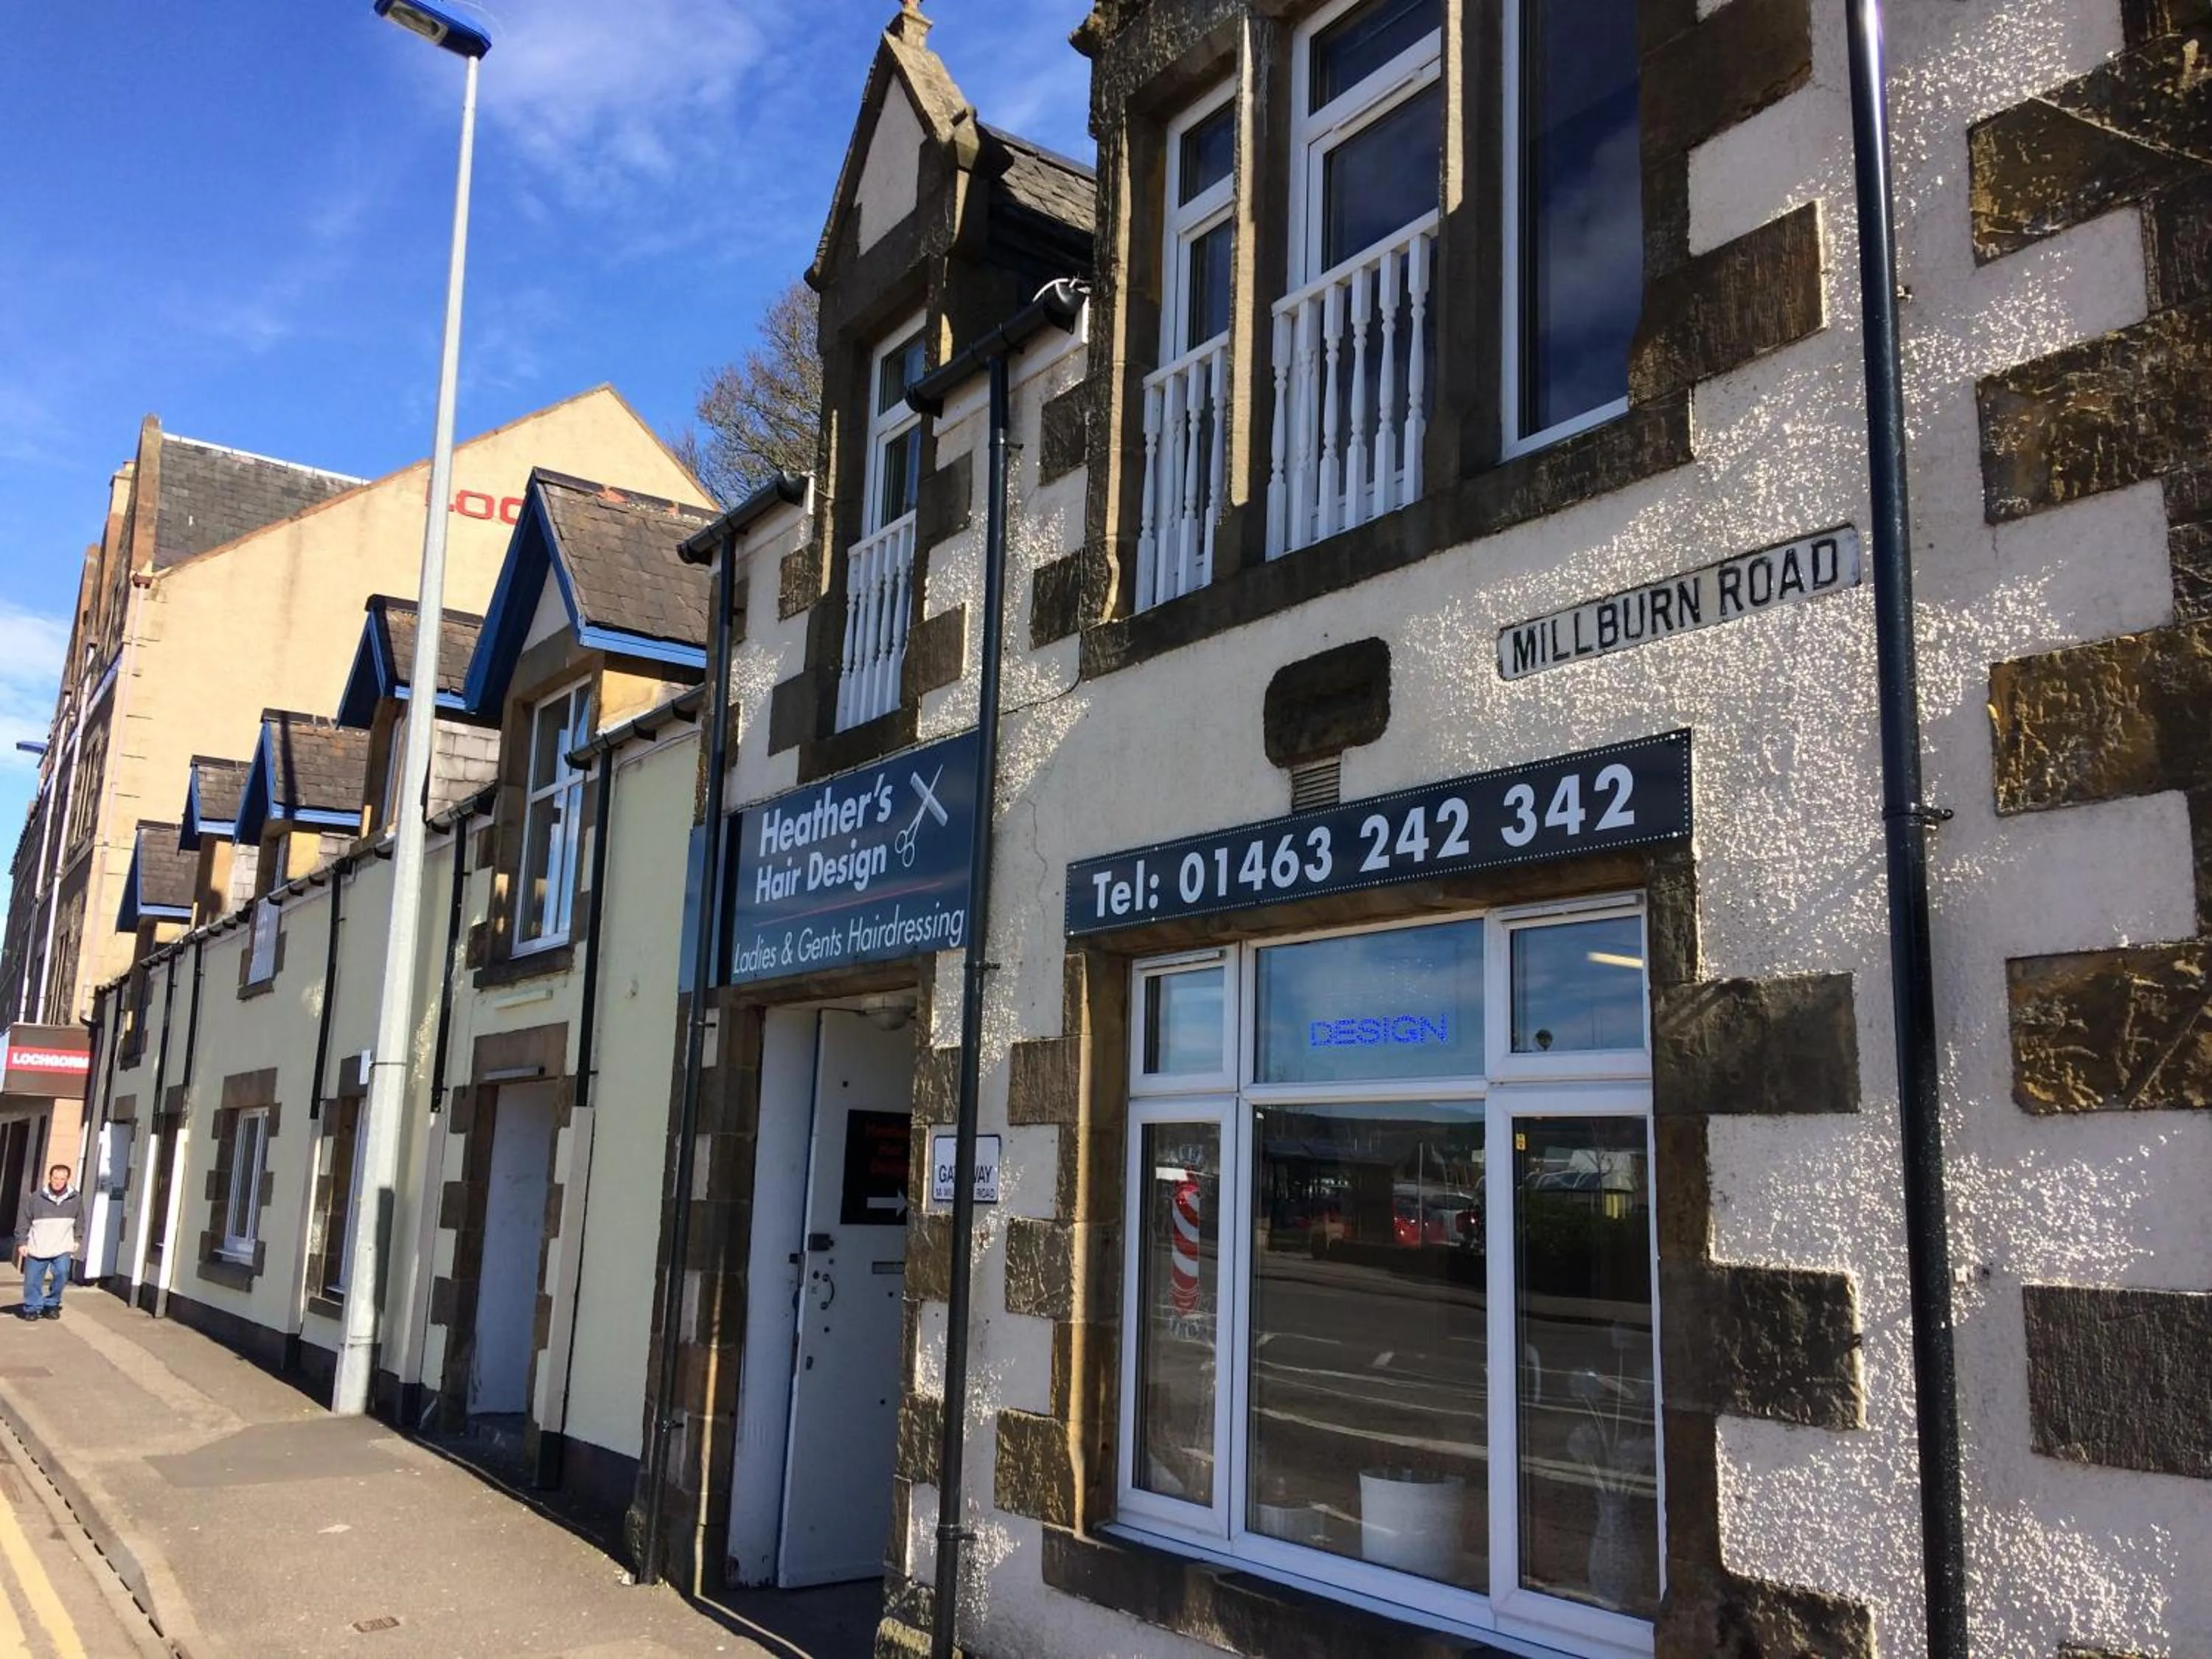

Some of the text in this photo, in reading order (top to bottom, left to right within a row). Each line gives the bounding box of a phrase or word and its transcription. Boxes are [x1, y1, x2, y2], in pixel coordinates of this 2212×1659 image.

[1513, 537, 1839, 674] MILLBURN ROAD
[759, 773, 893, 857] Heather's
[1093, 763, 1635, 918] Tel: 01463 242 342
[755, 838, 888, 905] Hair Design
[732, 902, 965, 975] Ladies & Gents Hairdressing
[1310, 1014, 1449, 1047] DESIGN
